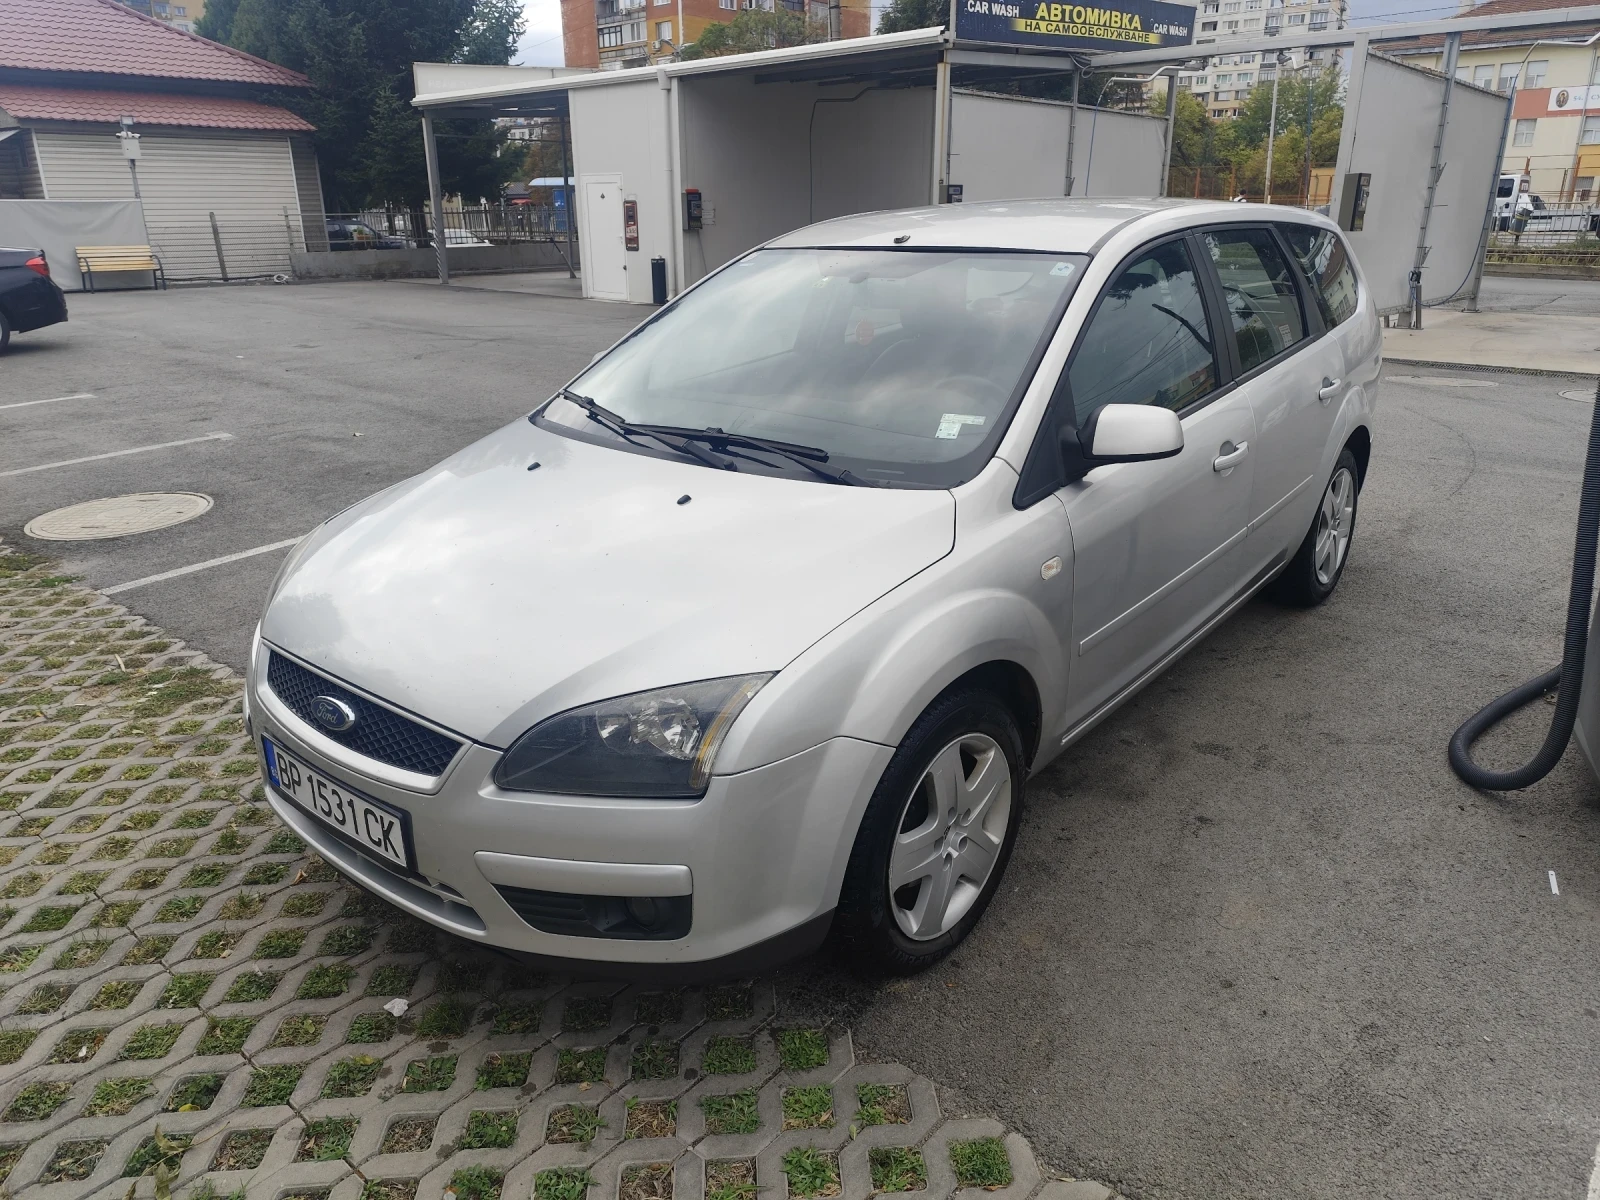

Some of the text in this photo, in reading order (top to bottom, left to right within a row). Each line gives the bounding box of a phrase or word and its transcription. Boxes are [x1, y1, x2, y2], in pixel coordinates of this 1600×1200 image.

[967, 0, 1020, 18] CAR WASH
[1035, 2, 1142, 31] АВТОМИВКА
[1024, 20, 1150, 43] НА САМООБСЛУЖВАНЕ
[1153, 23, 1188, 37] CAR WASH
[316, 702, 338, 724] Ford
[276, 751, 401, 859] BP 1531 CK
